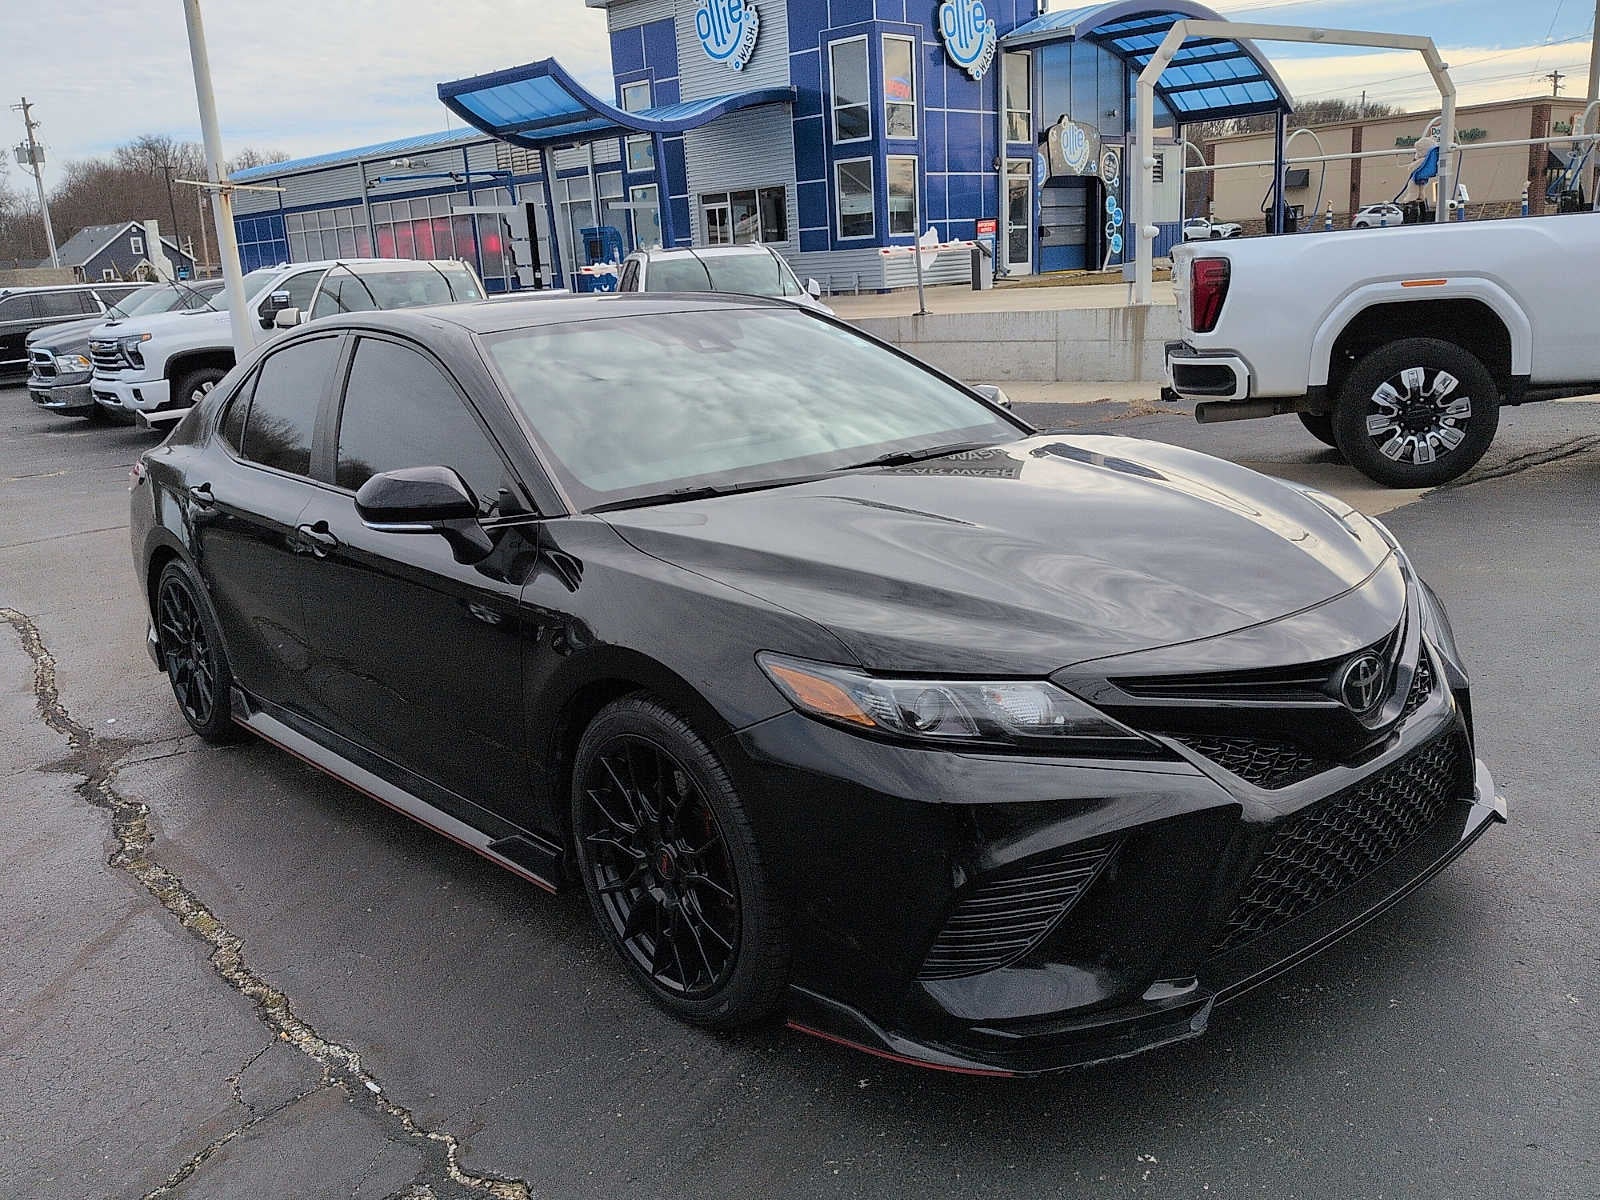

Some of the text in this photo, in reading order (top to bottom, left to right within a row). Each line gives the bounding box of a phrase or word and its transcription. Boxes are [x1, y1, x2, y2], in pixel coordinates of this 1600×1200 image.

[696, 0, 743, 47] ollie
[738, 26, 756, 61] WASH
[943, 0, 986, 49] ollie
[979, 40, 995, 73] WASH
